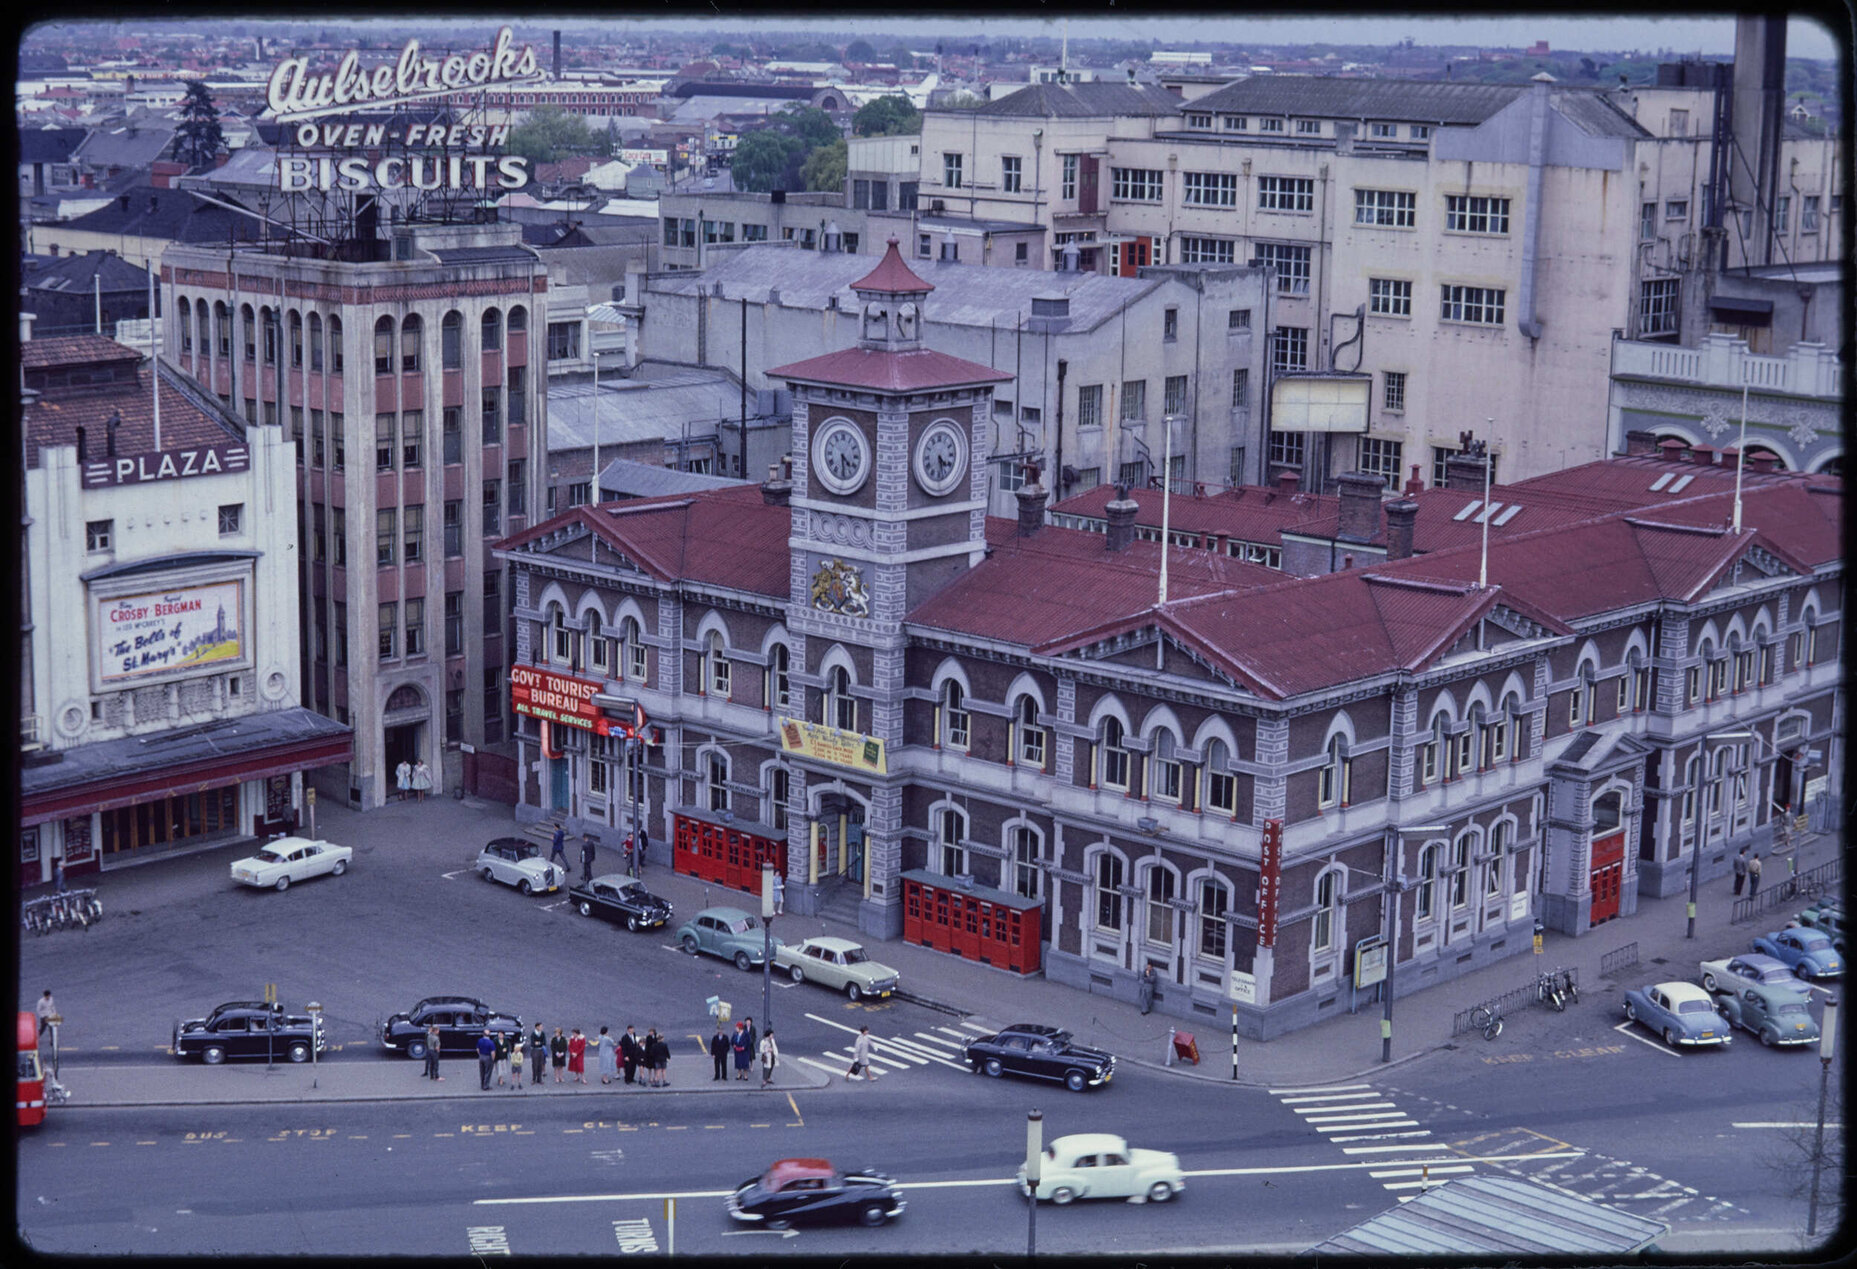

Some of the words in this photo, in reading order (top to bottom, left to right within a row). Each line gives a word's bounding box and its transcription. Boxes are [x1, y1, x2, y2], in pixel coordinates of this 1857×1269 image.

[267, 26, 537, 113] Aulsebrooks
[297, 123, 509, 148] OVEN-FRESH
[278, 155, 529, 192] BISCUITS
[116, 449, 222, 483] PLAZA
[110, 607, 149, 622] CROSBY
[154, 599, 202, 617] BERGMAN
[134, 628, 165, 650] Bells
[169, 621, 182, 640] of
[546, 675, 599, 699] TOURIST
[531, 689, 579, 713] BUREAU
[532, 706, 558, 721] TRAVEL
[559, 714, 593, 729] SERVICES
[1259, 876, 1270, 946] OFFICE
[184, 1131, 229, 1140] BUS
[278, 1128, 337, 1138] STOP
